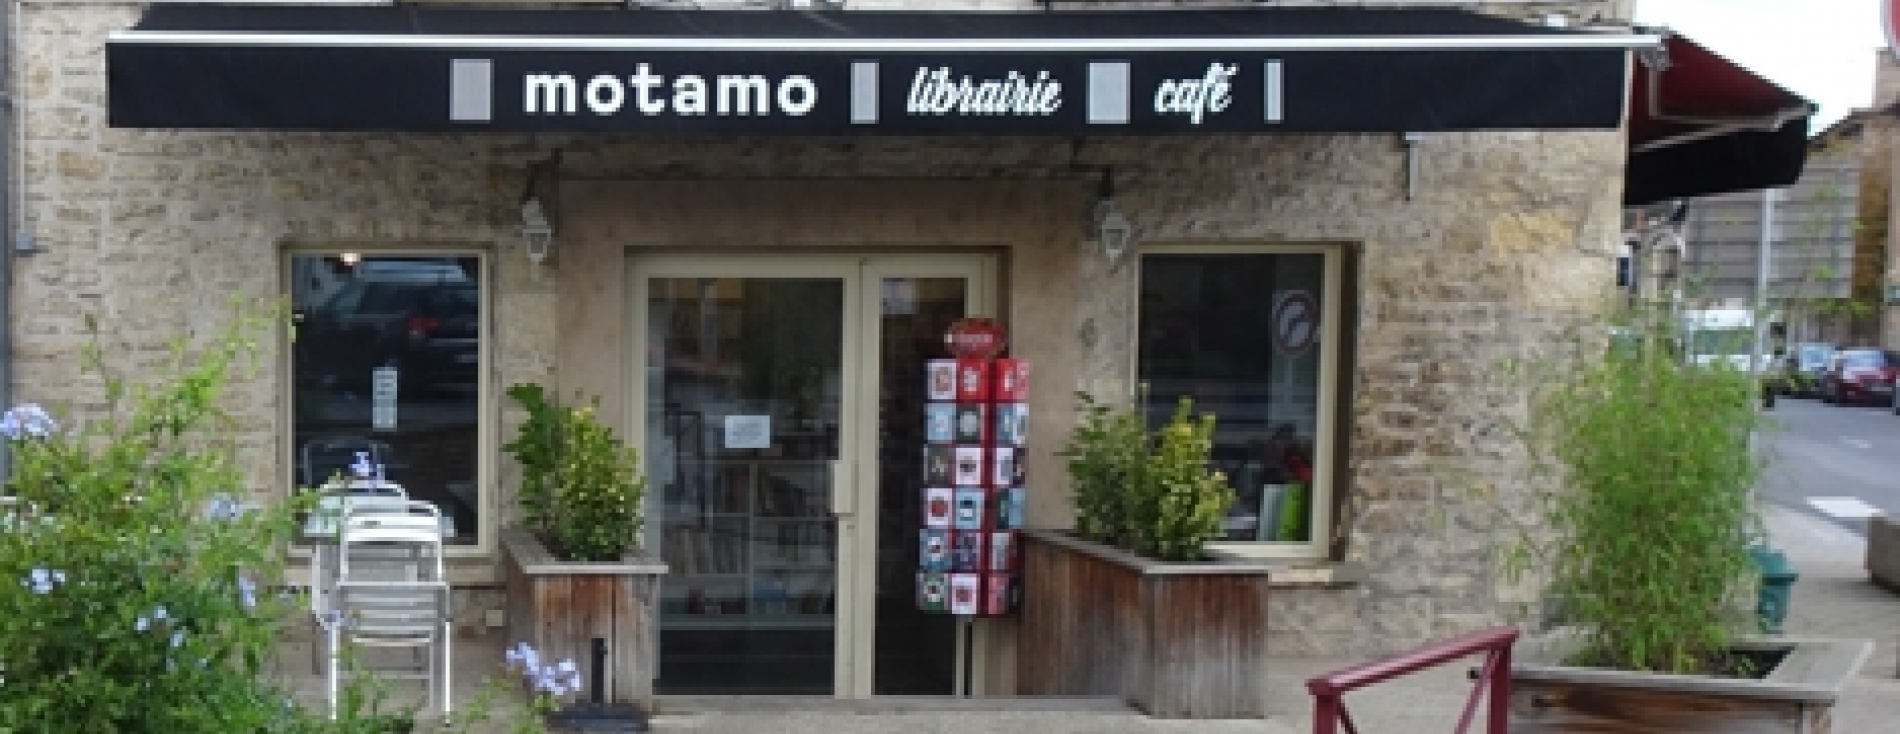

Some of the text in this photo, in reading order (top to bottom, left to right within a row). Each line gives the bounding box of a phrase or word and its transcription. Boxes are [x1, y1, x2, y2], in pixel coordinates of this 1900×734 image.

[524, 62, 1239, 125] motamo librairie café
